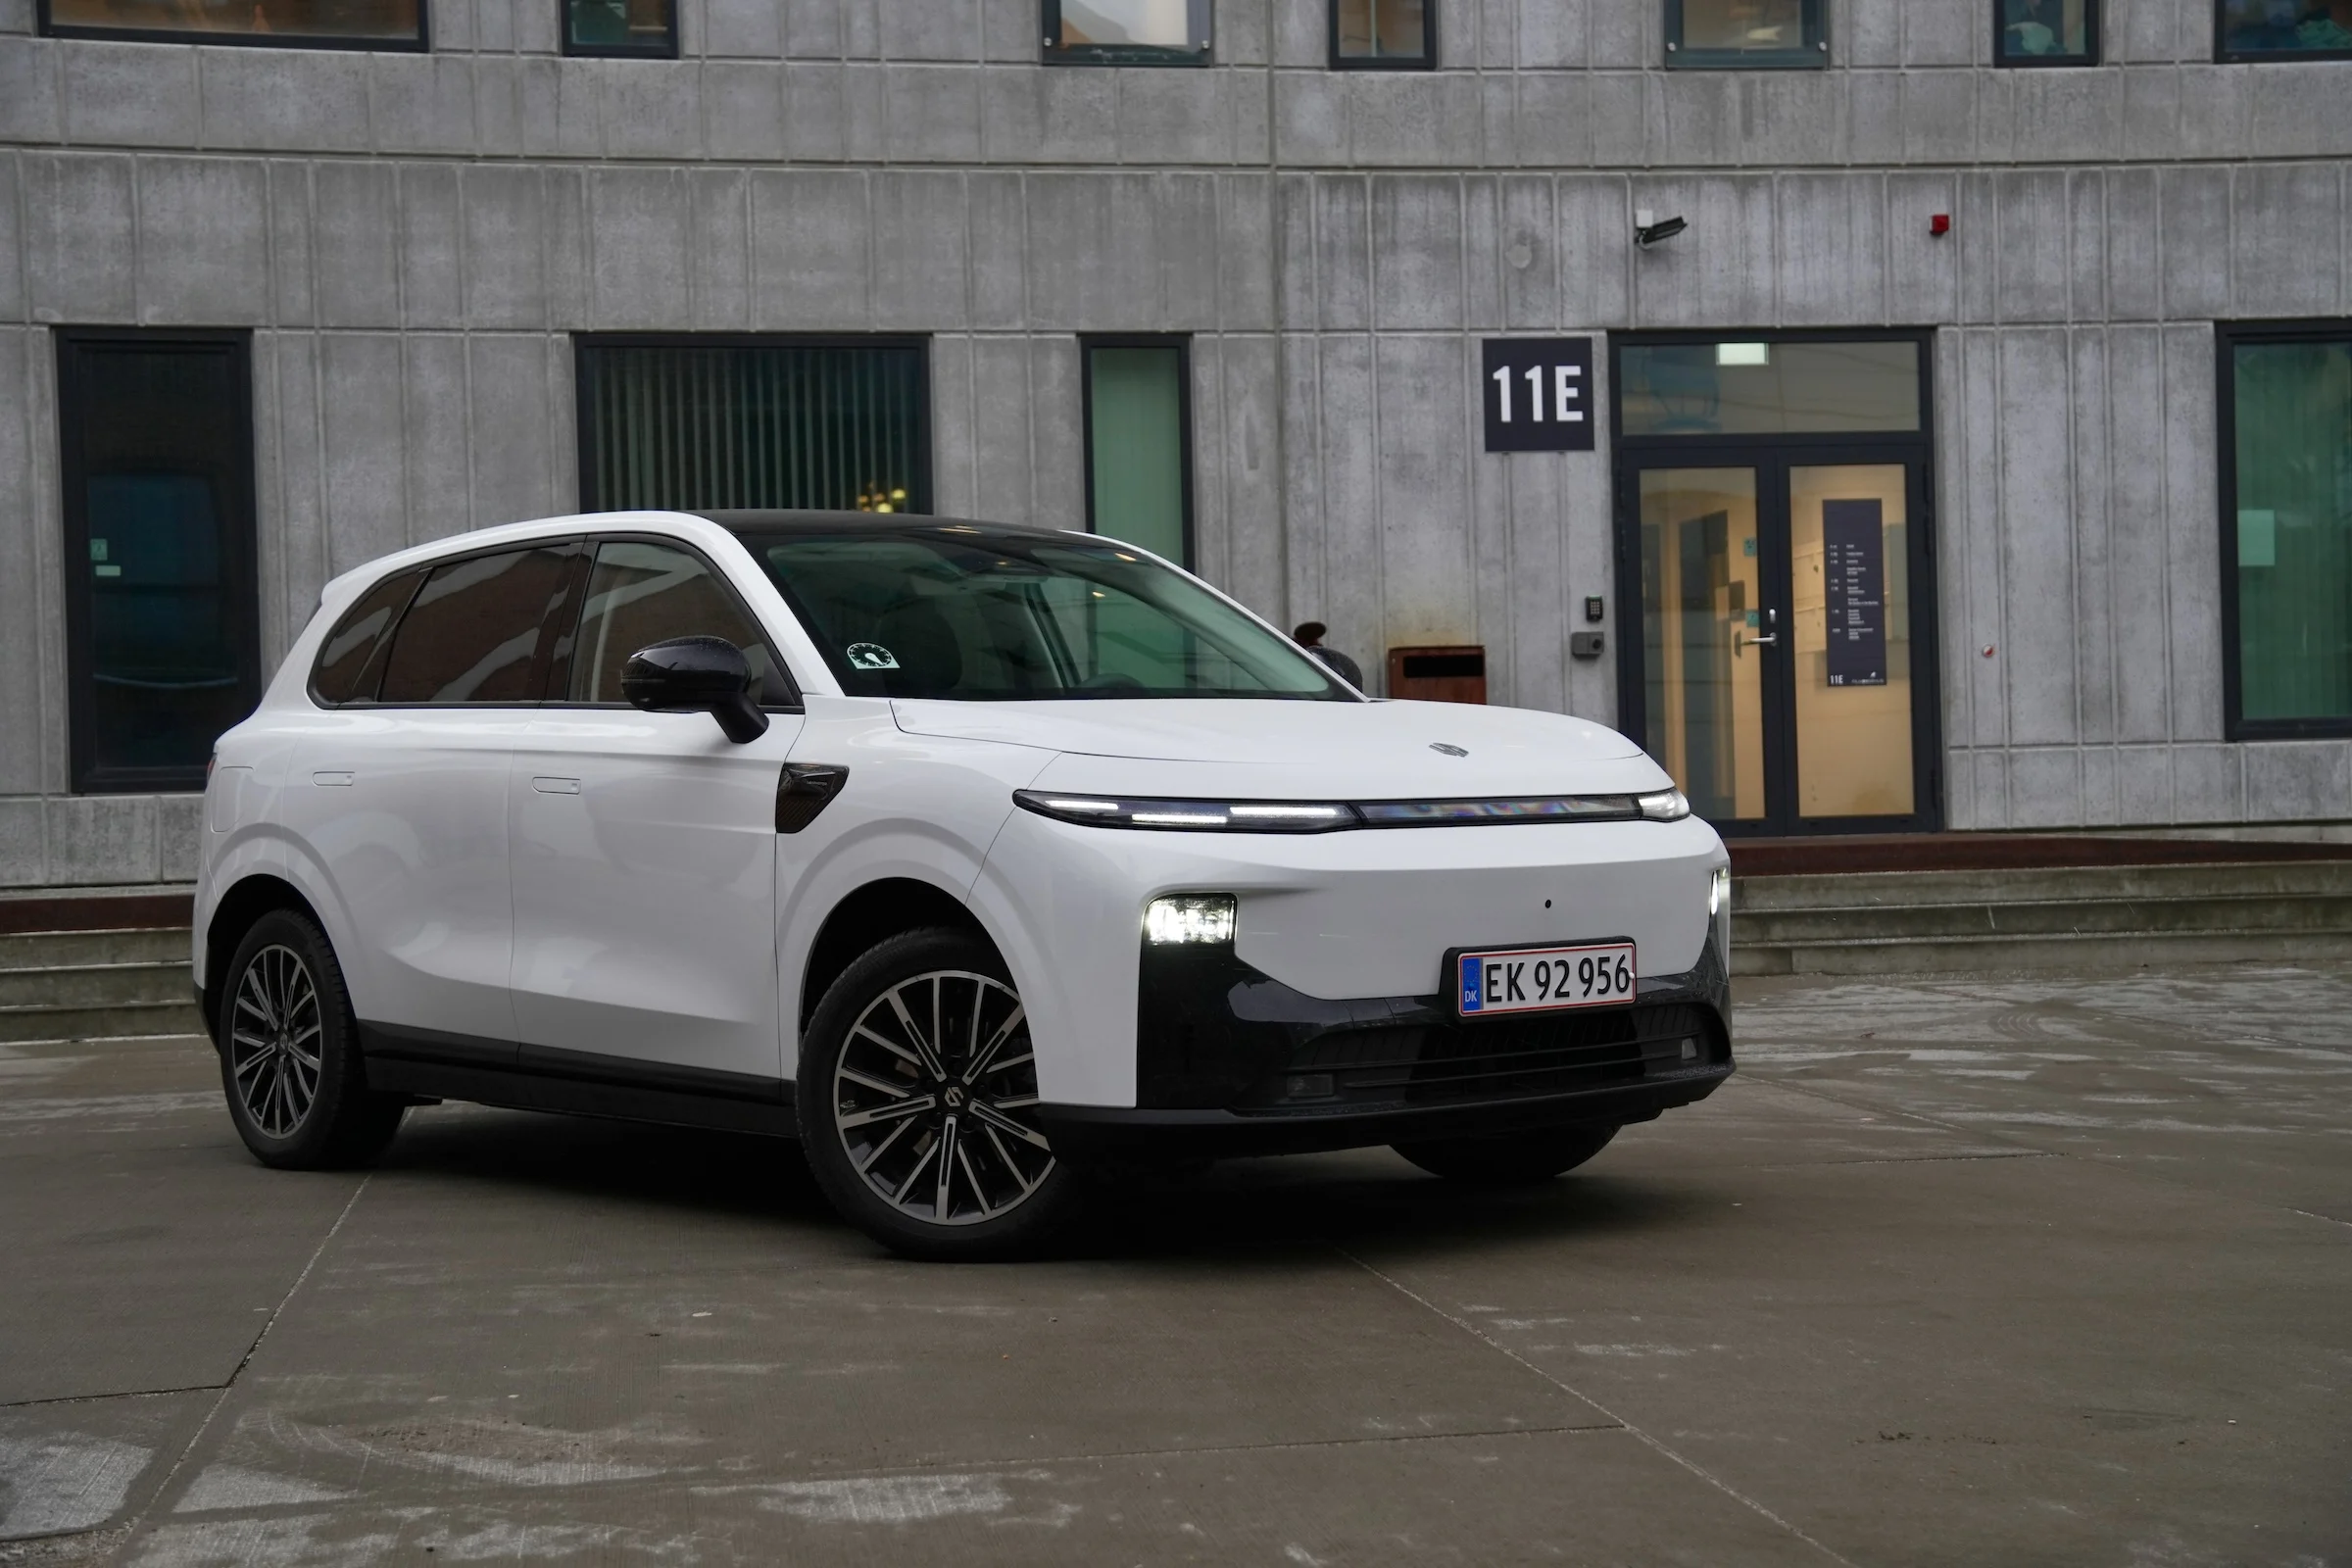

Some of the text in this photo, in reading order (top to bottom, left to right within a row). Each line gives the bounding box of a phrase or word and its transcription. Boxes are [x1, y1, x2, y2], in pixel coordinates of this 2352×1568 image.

[1493, 365, 1584, 423] 11E
[1830, 674, 1844, 685] 11E
[1486, 954, 1631, 1004] EK 92 956
[1464, 990, 1478, 1003] DK
